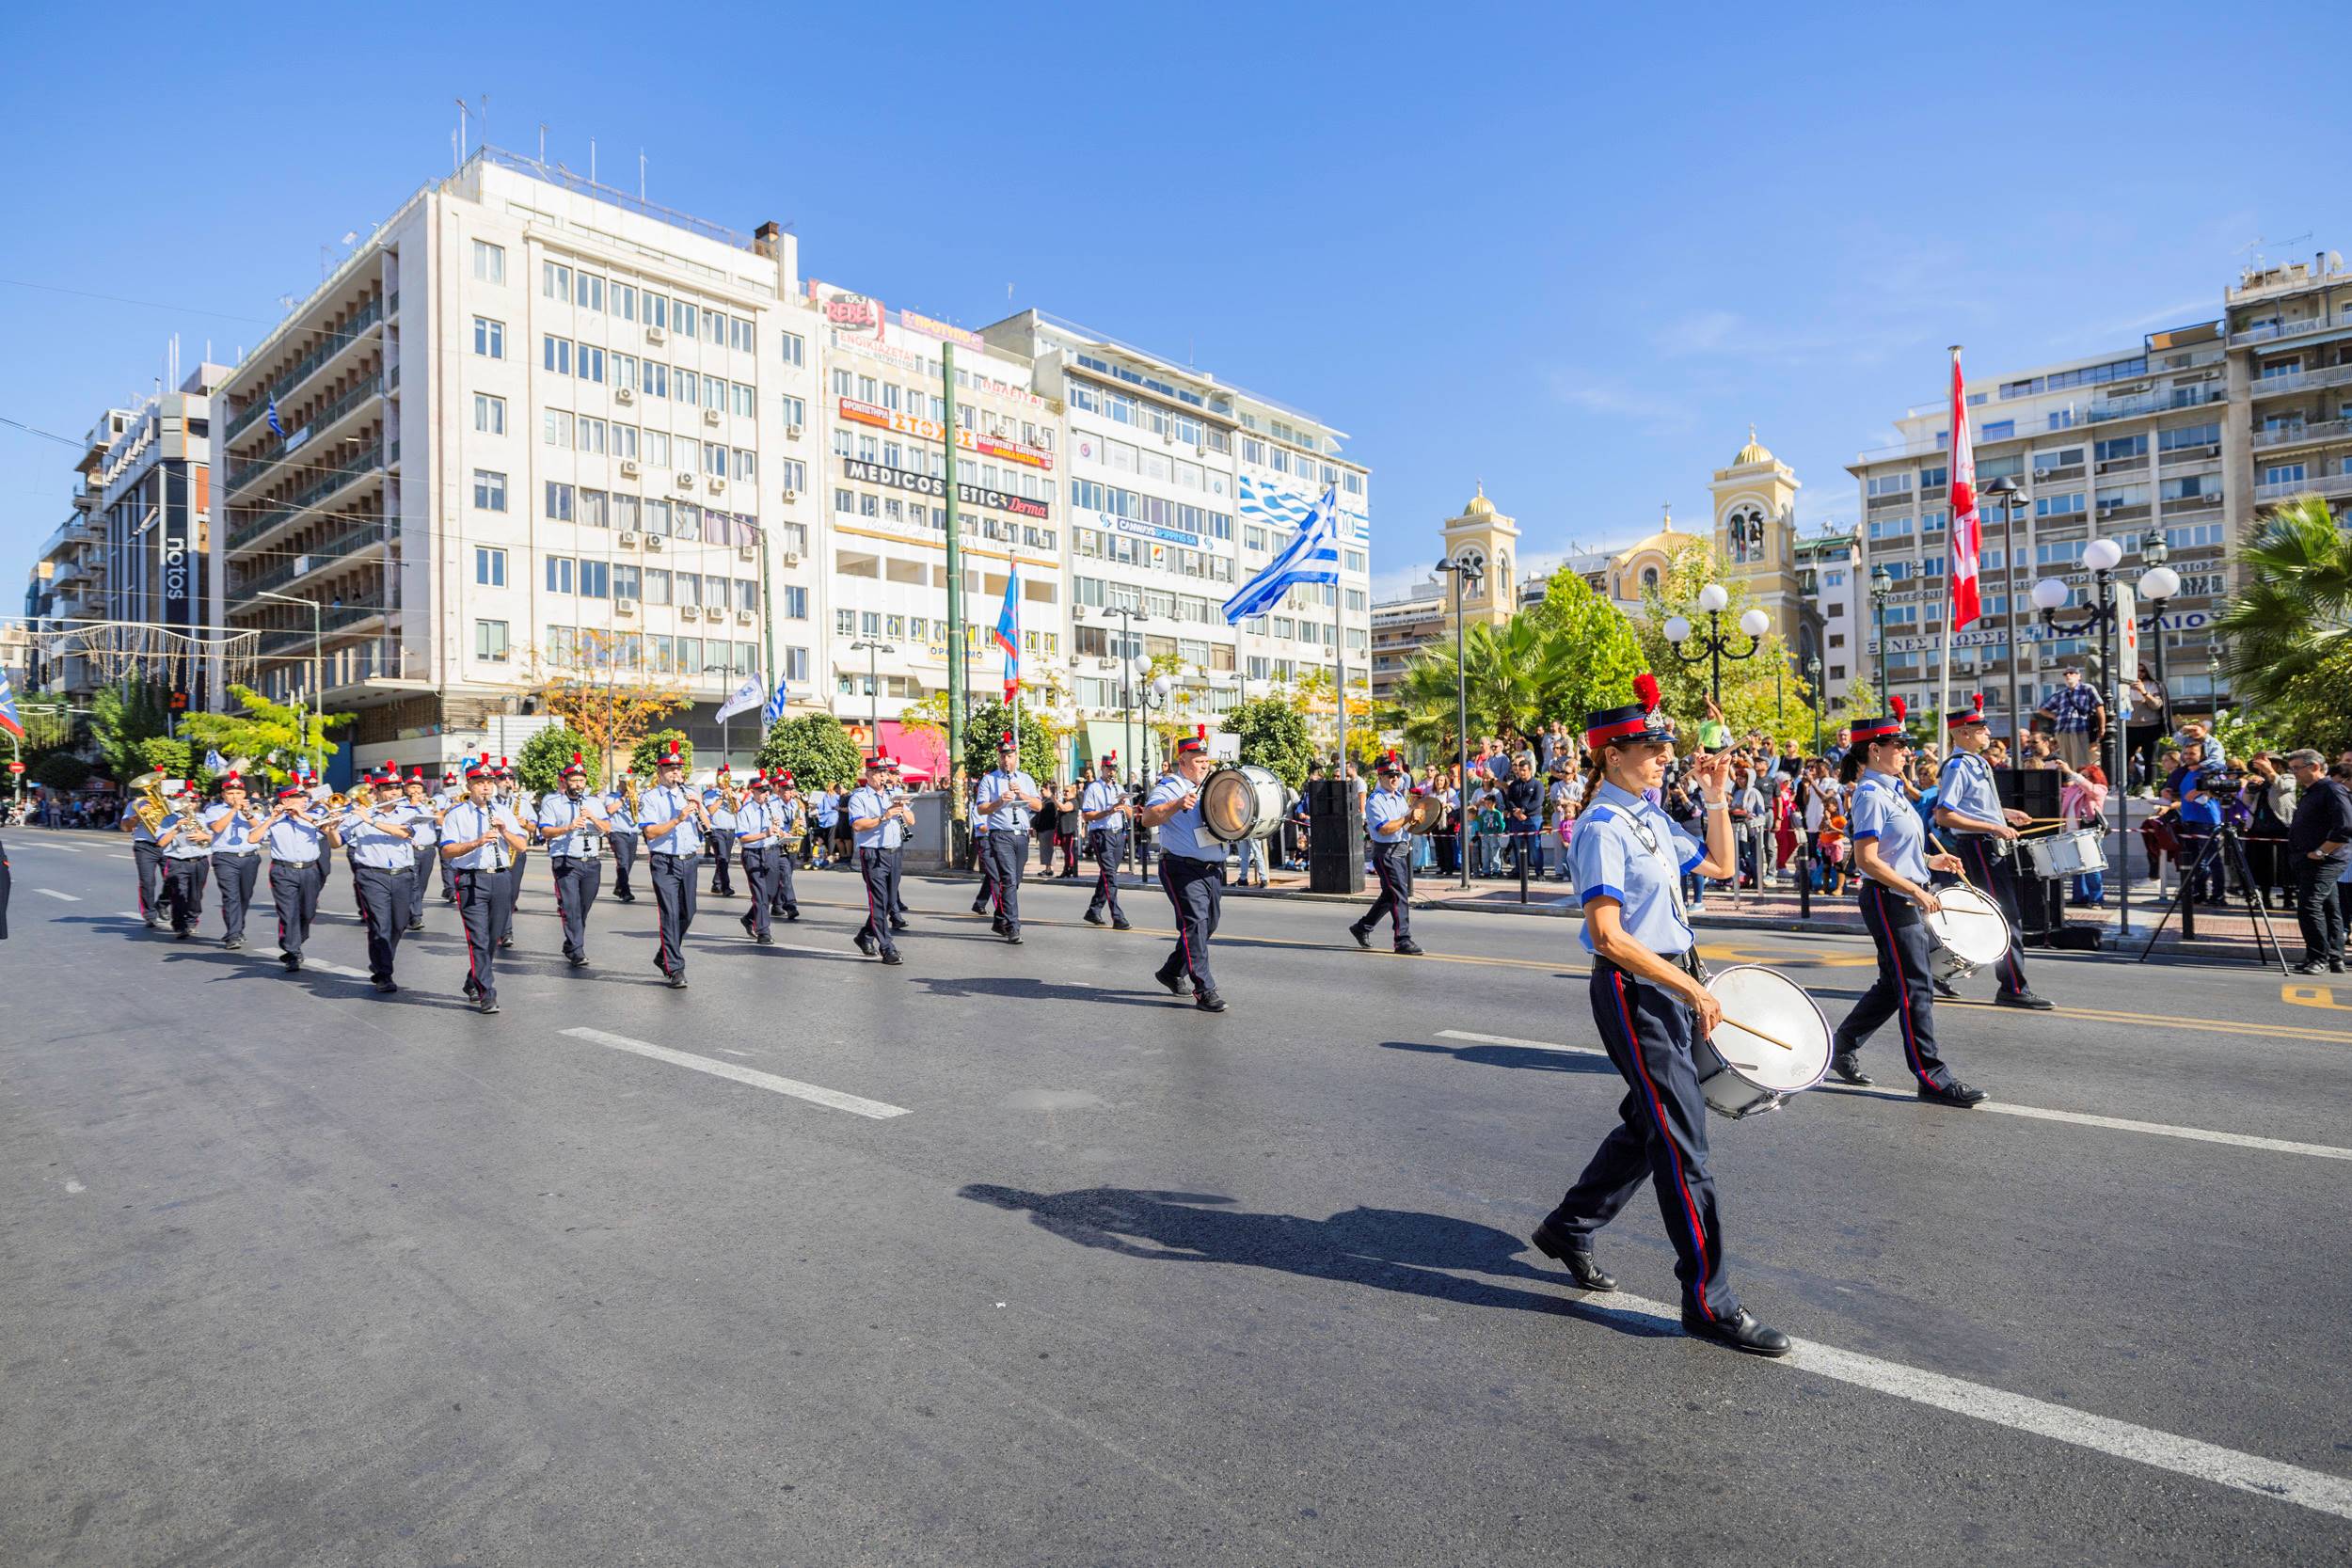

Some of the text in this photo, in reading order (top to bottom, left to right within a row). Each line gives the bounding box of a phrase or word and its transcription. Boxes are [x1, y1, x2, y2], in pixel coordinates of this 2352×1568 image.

[825, 301, 875, 325] REBEL
[849, 462, 1046, 517] MEDICOSETIC Derma
[167, 537, 187, 600] notos
